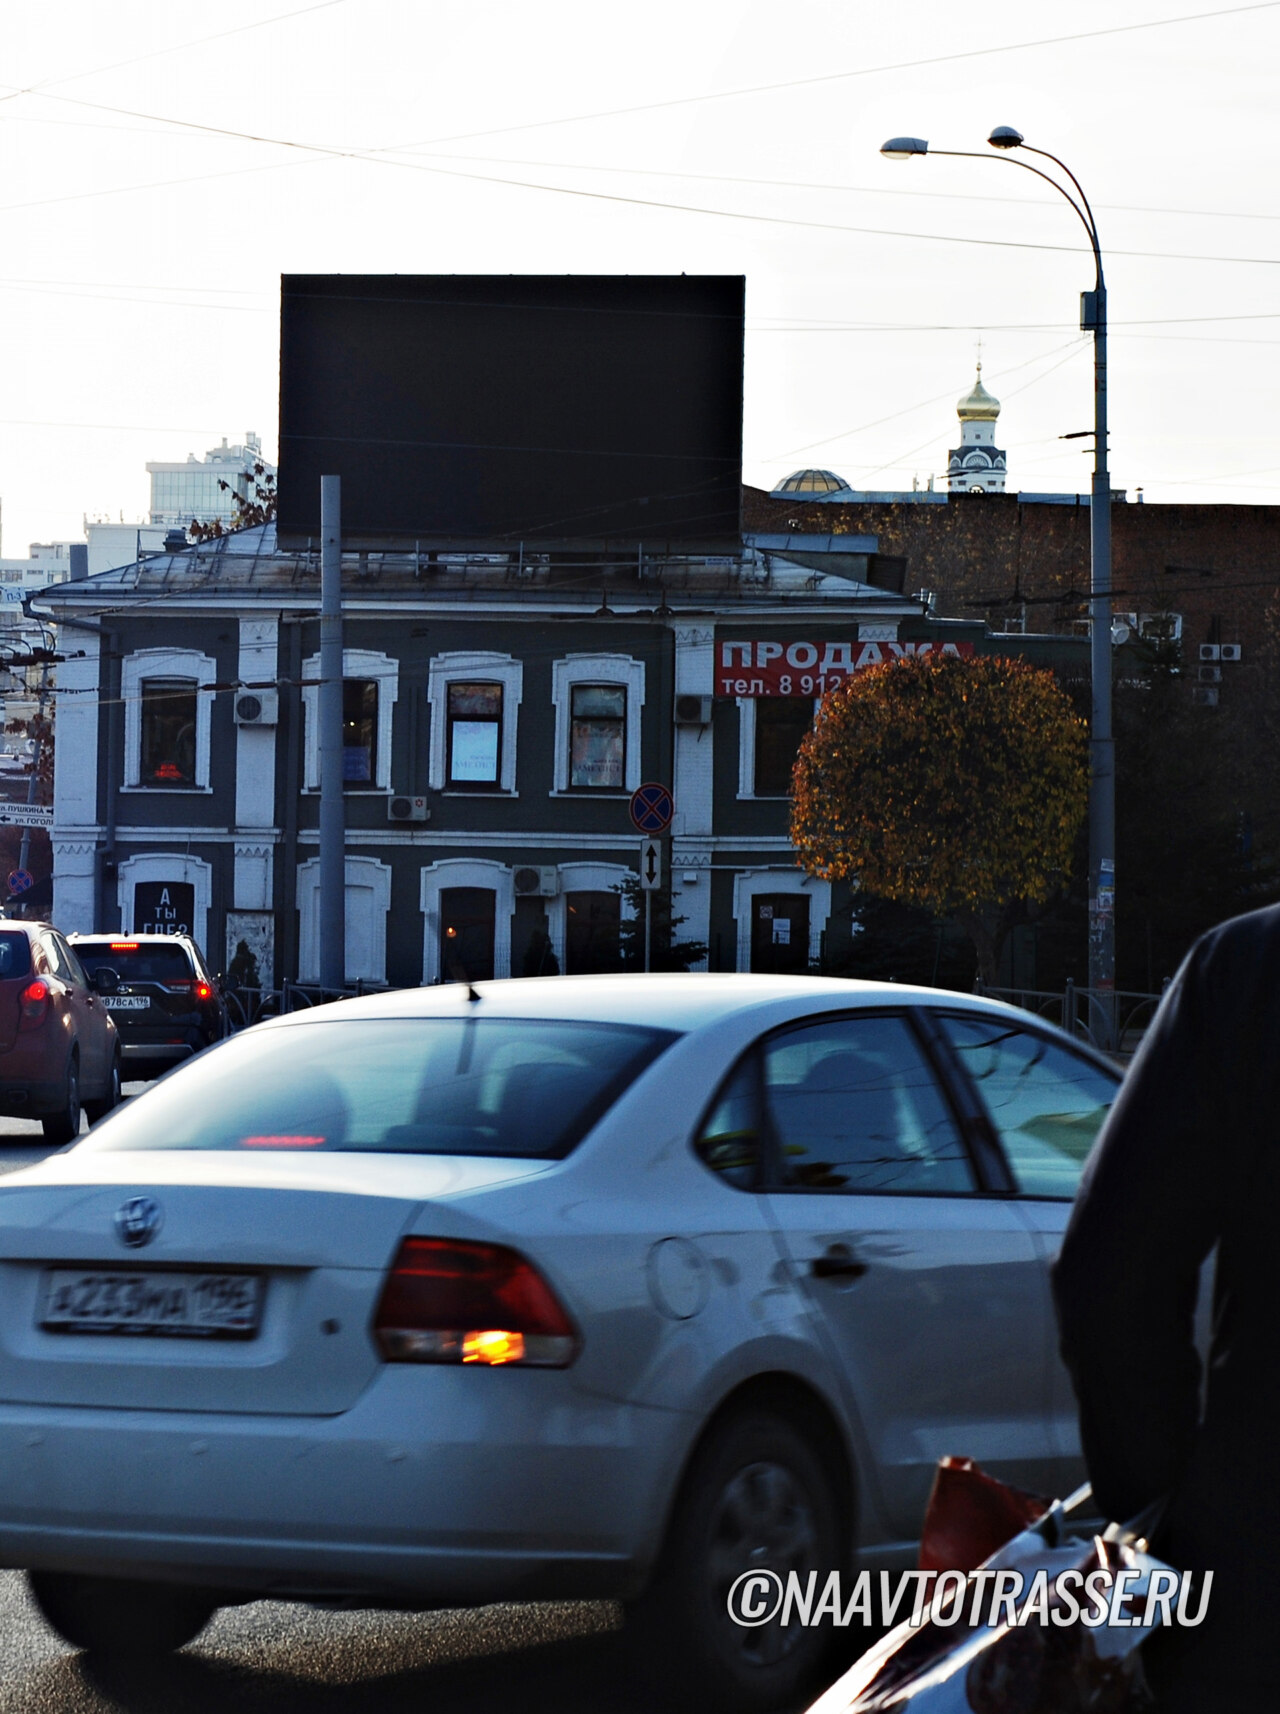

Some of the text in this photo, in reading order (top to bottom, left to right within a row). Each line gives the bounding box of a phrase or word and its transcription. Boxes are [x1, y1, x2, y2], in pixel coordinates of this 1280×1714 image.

[721, 678, 770, 695] тел.
[779, 675, 792, 695] 8
[7, 804, 45, 815] ПУШКИНА
[160, 887, 171, 905] А
